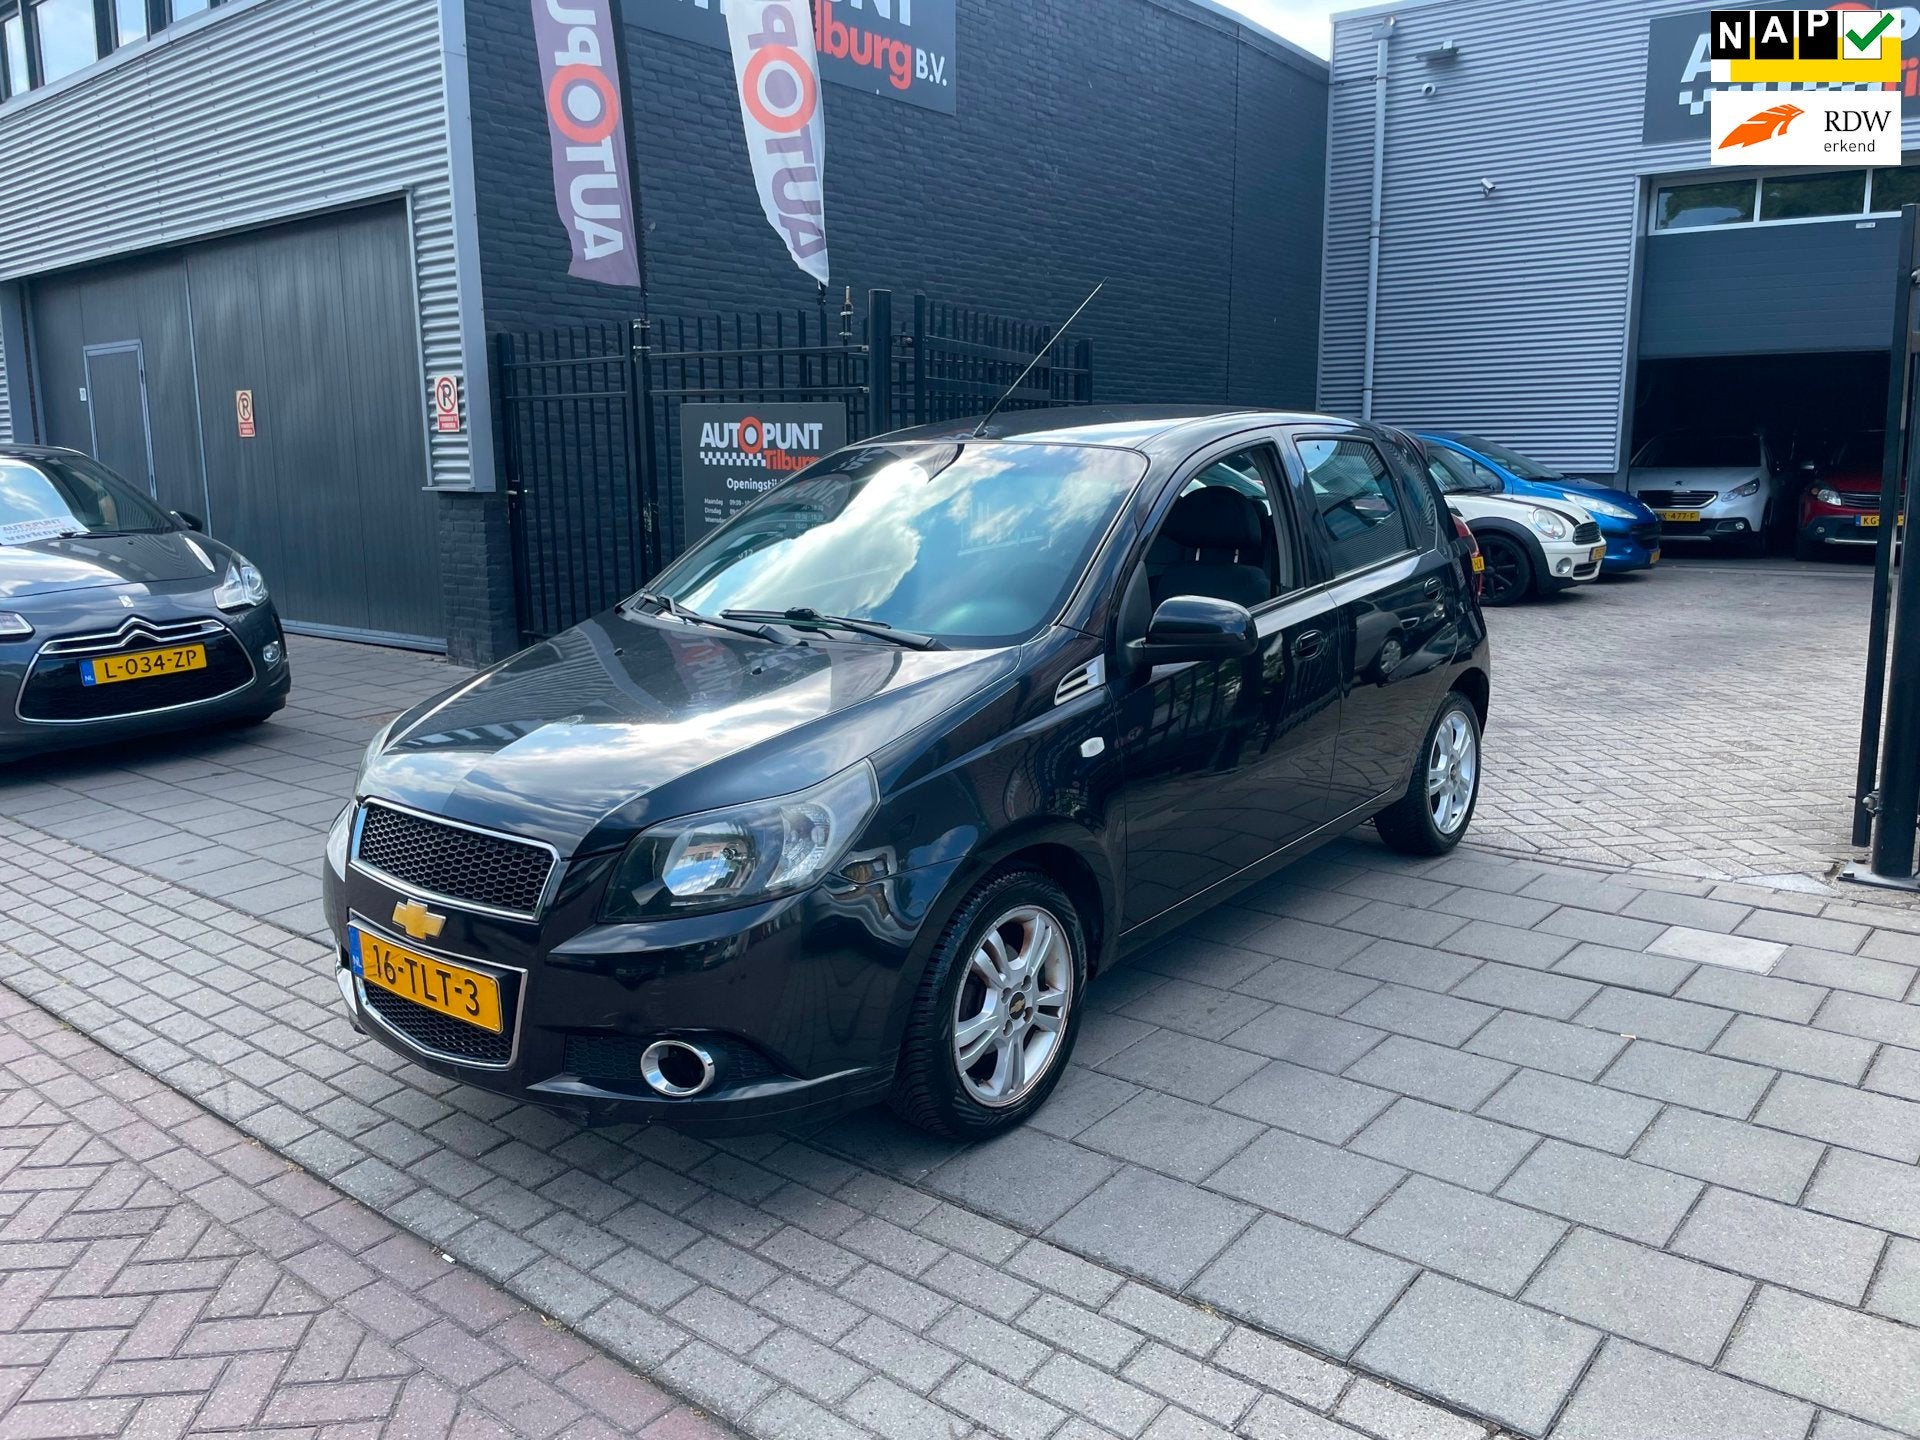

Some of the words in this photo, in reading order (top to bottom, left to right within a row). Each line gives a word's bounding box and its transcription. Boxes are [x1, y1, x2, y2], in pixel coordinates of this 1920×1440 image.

[915, 47, 948, 87] B.V.
[700, 416, 823, 454] AUTOPUNT
[763, 449, 817, 471] Tilbur
[104, 649, 197, 679] L-034-ZP
[373, 944, 480, 1017] 16-TLT-3
